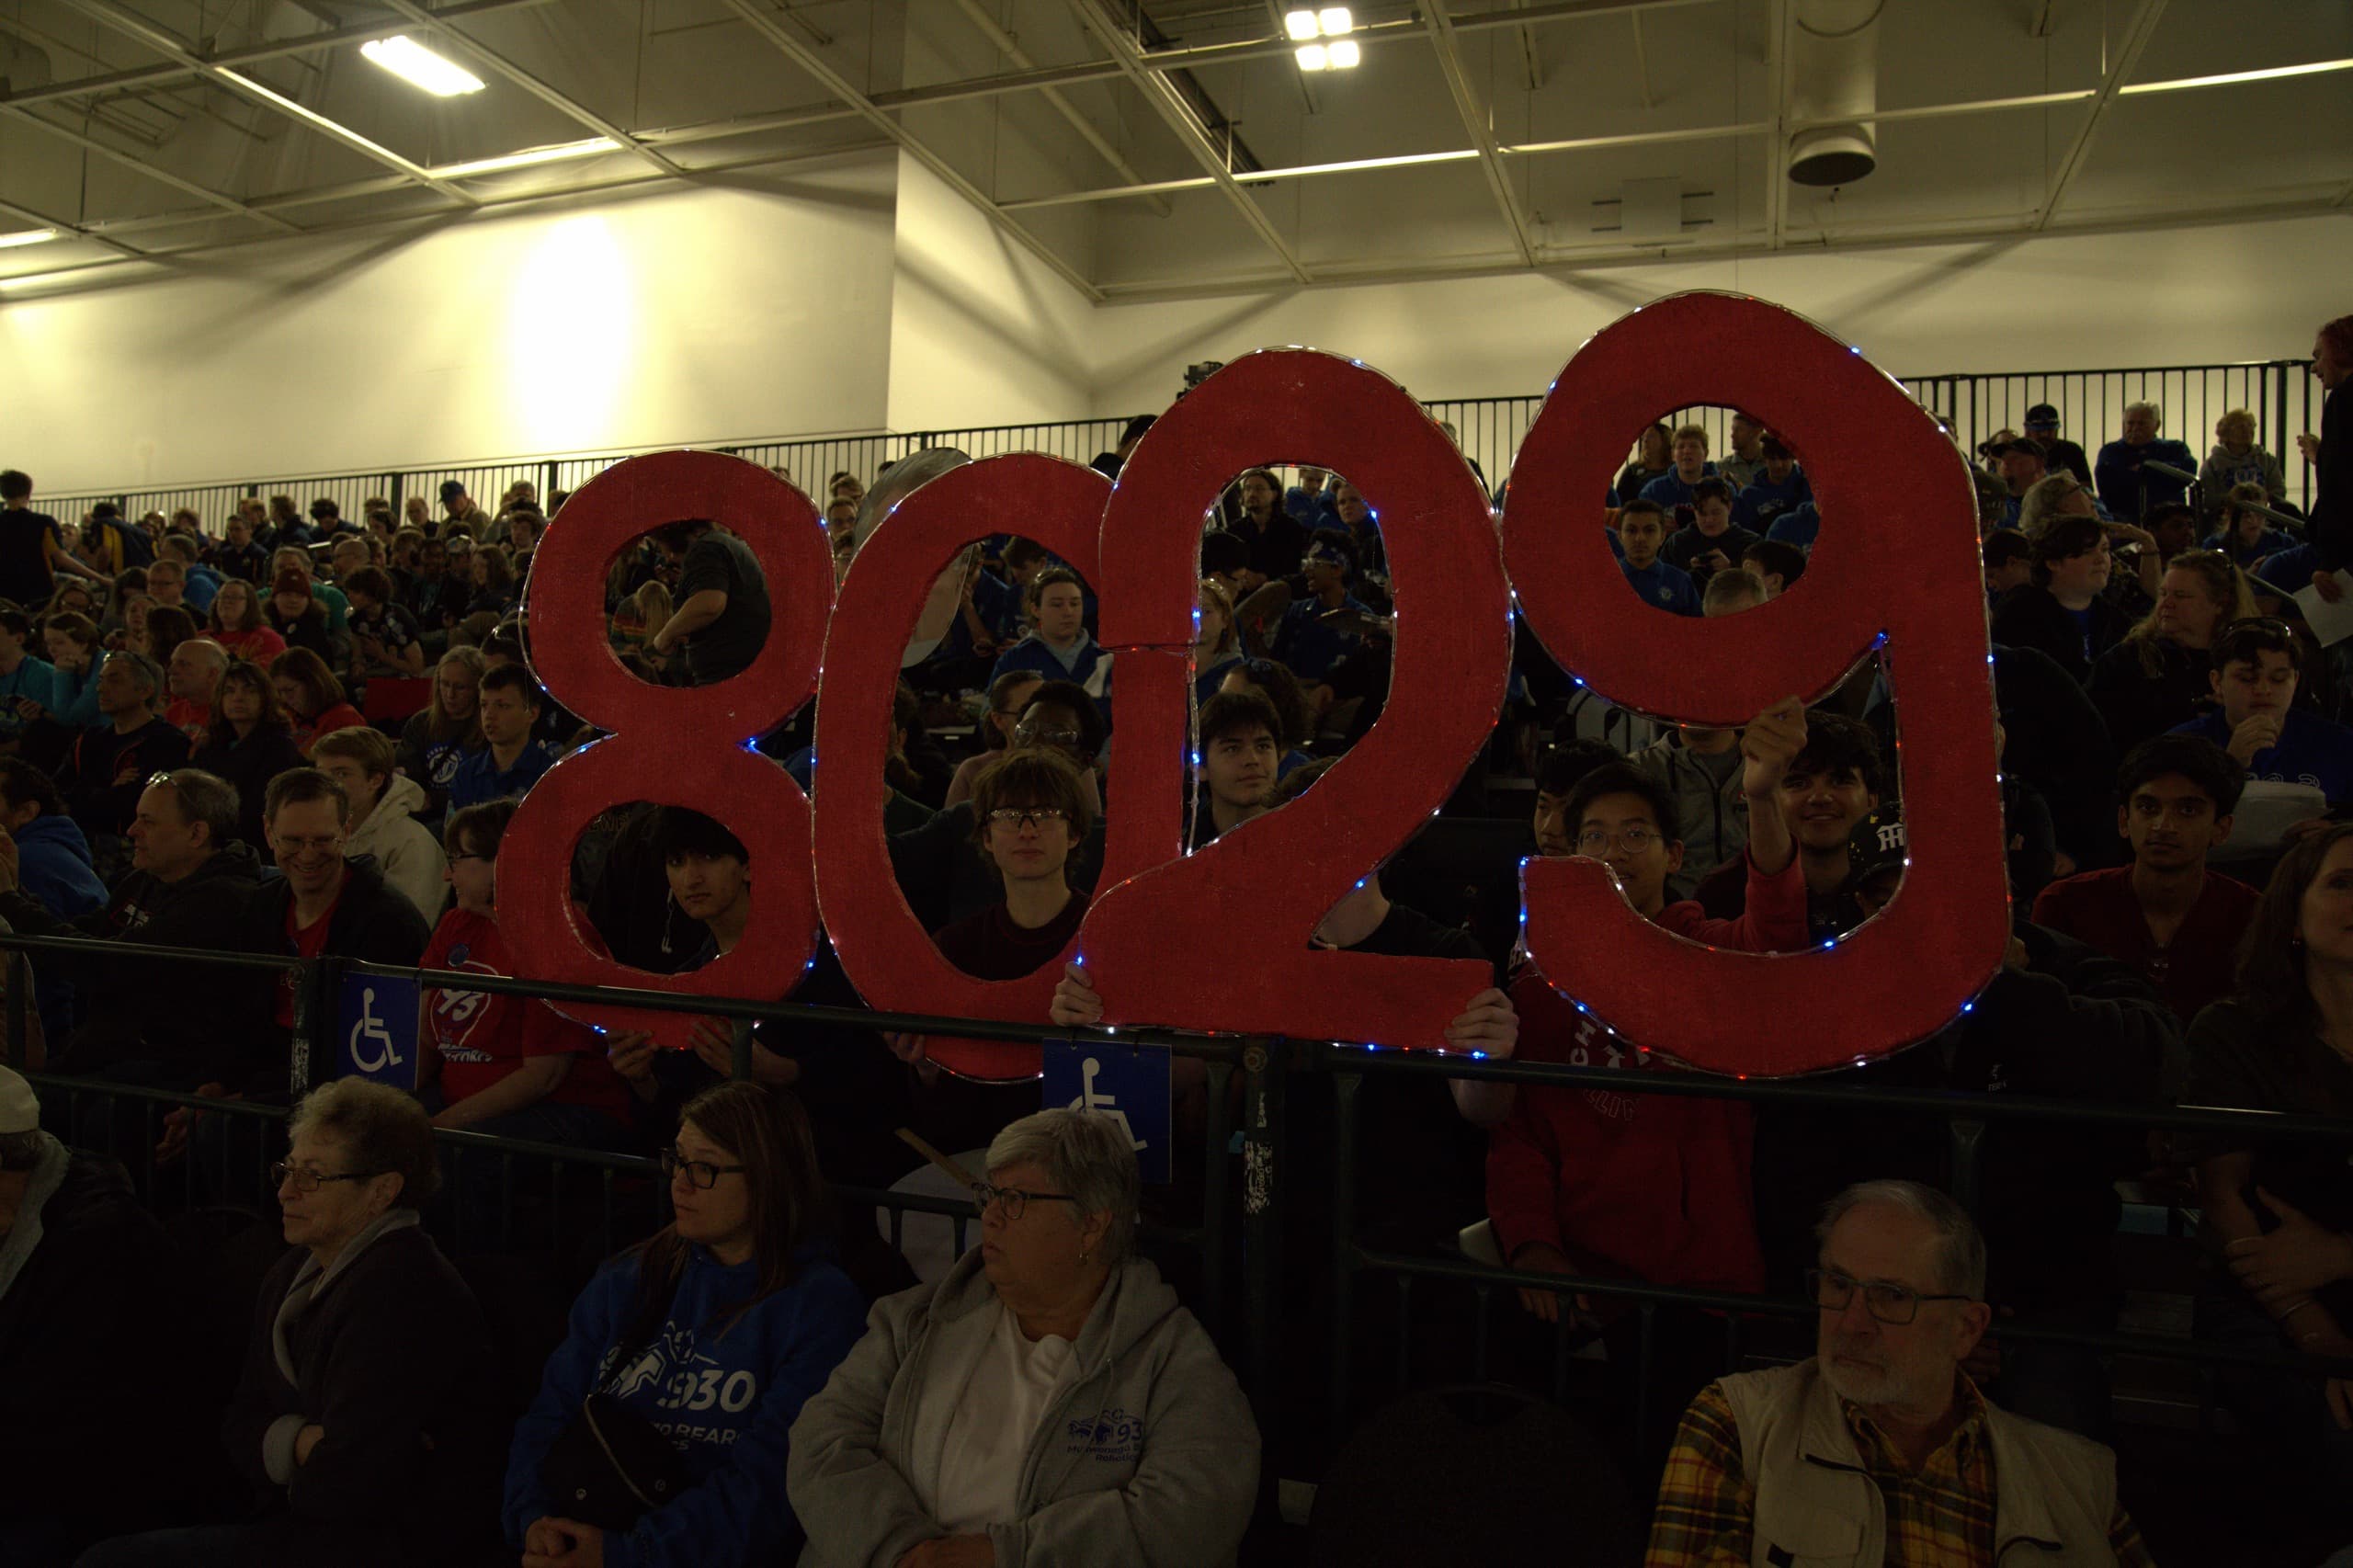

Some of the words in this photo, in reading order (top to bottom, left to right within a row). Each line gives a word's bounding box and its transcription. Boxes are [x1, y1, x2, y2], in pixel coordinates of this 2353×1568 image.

[493, 290, 2012, 1083] 8029
[655, 1369, 756, 1413] 930
[676, 1424, 741, 1447] BEAR
